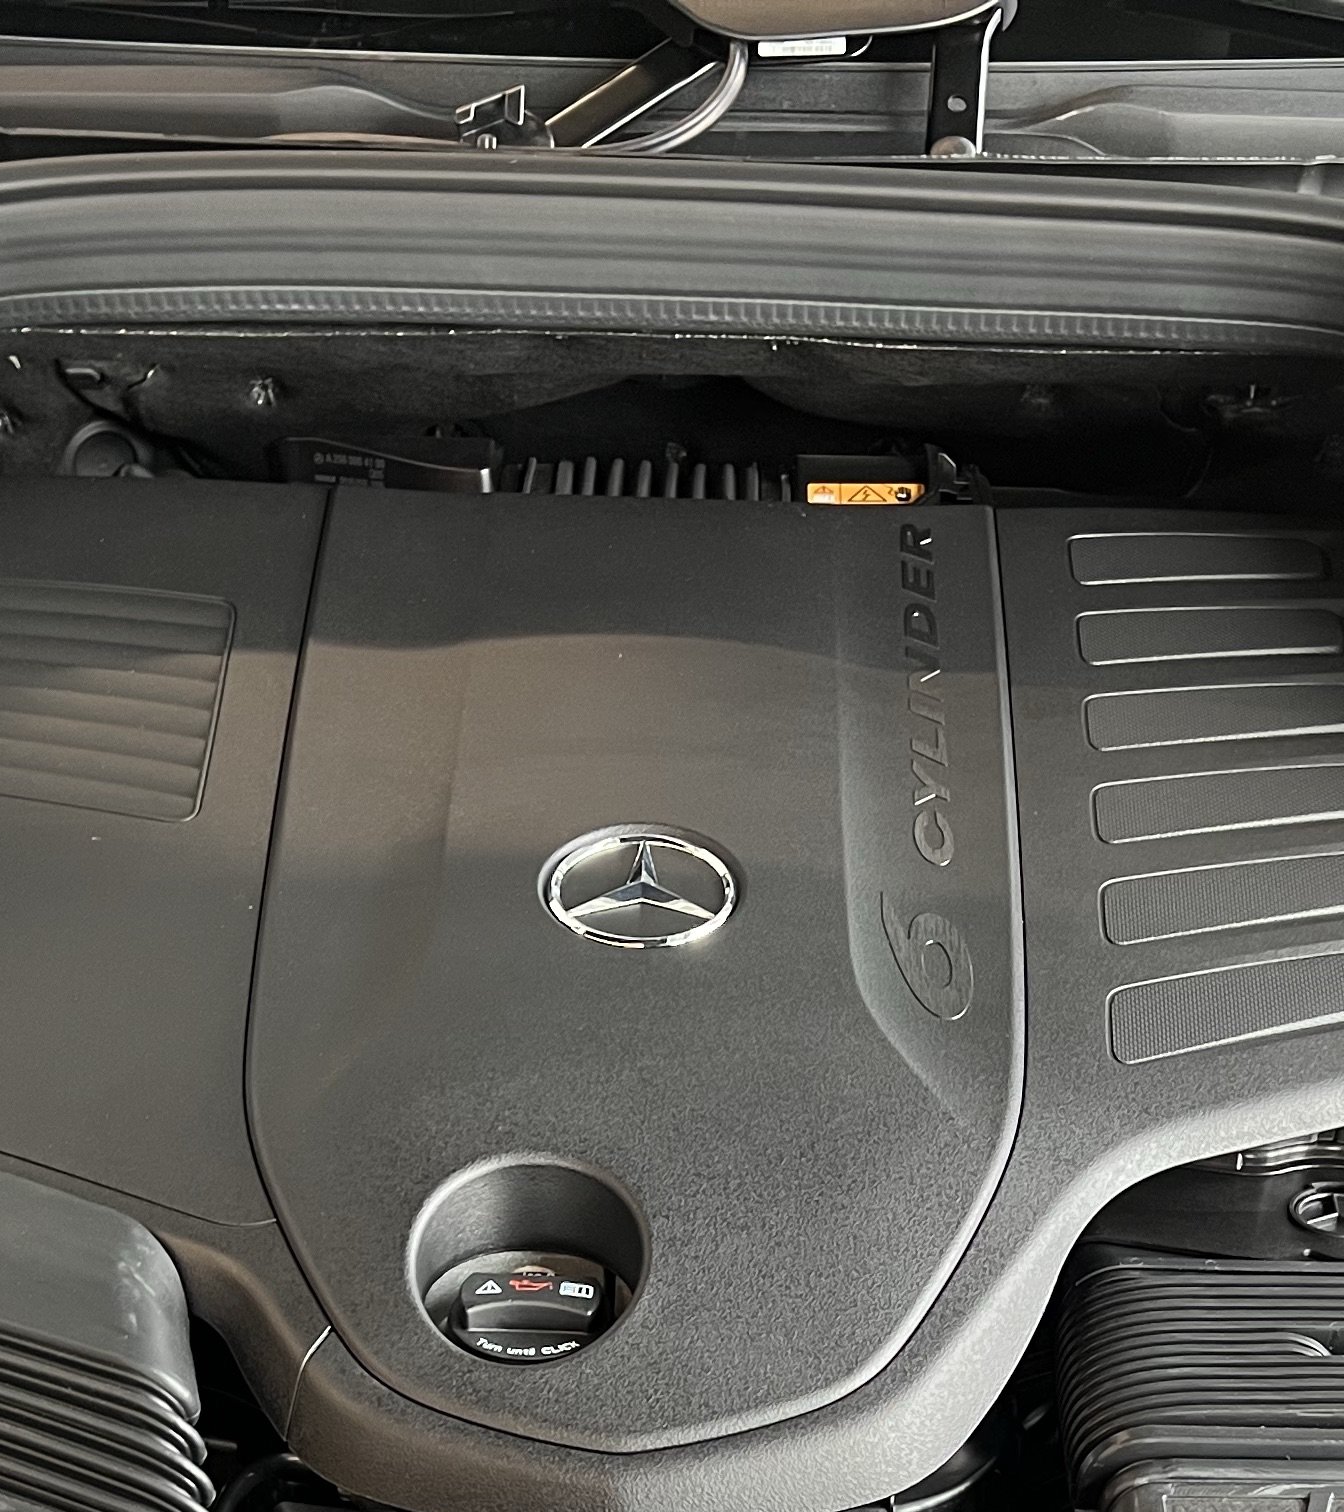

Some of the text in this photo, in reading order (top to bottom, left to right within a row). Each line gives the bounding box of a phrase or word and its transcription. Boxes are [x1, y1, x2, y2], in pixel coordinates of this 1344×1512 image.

[899, 522, 955, 867] CYLINDER
[476, 1337, 580, 1356] Turn until CLICK
